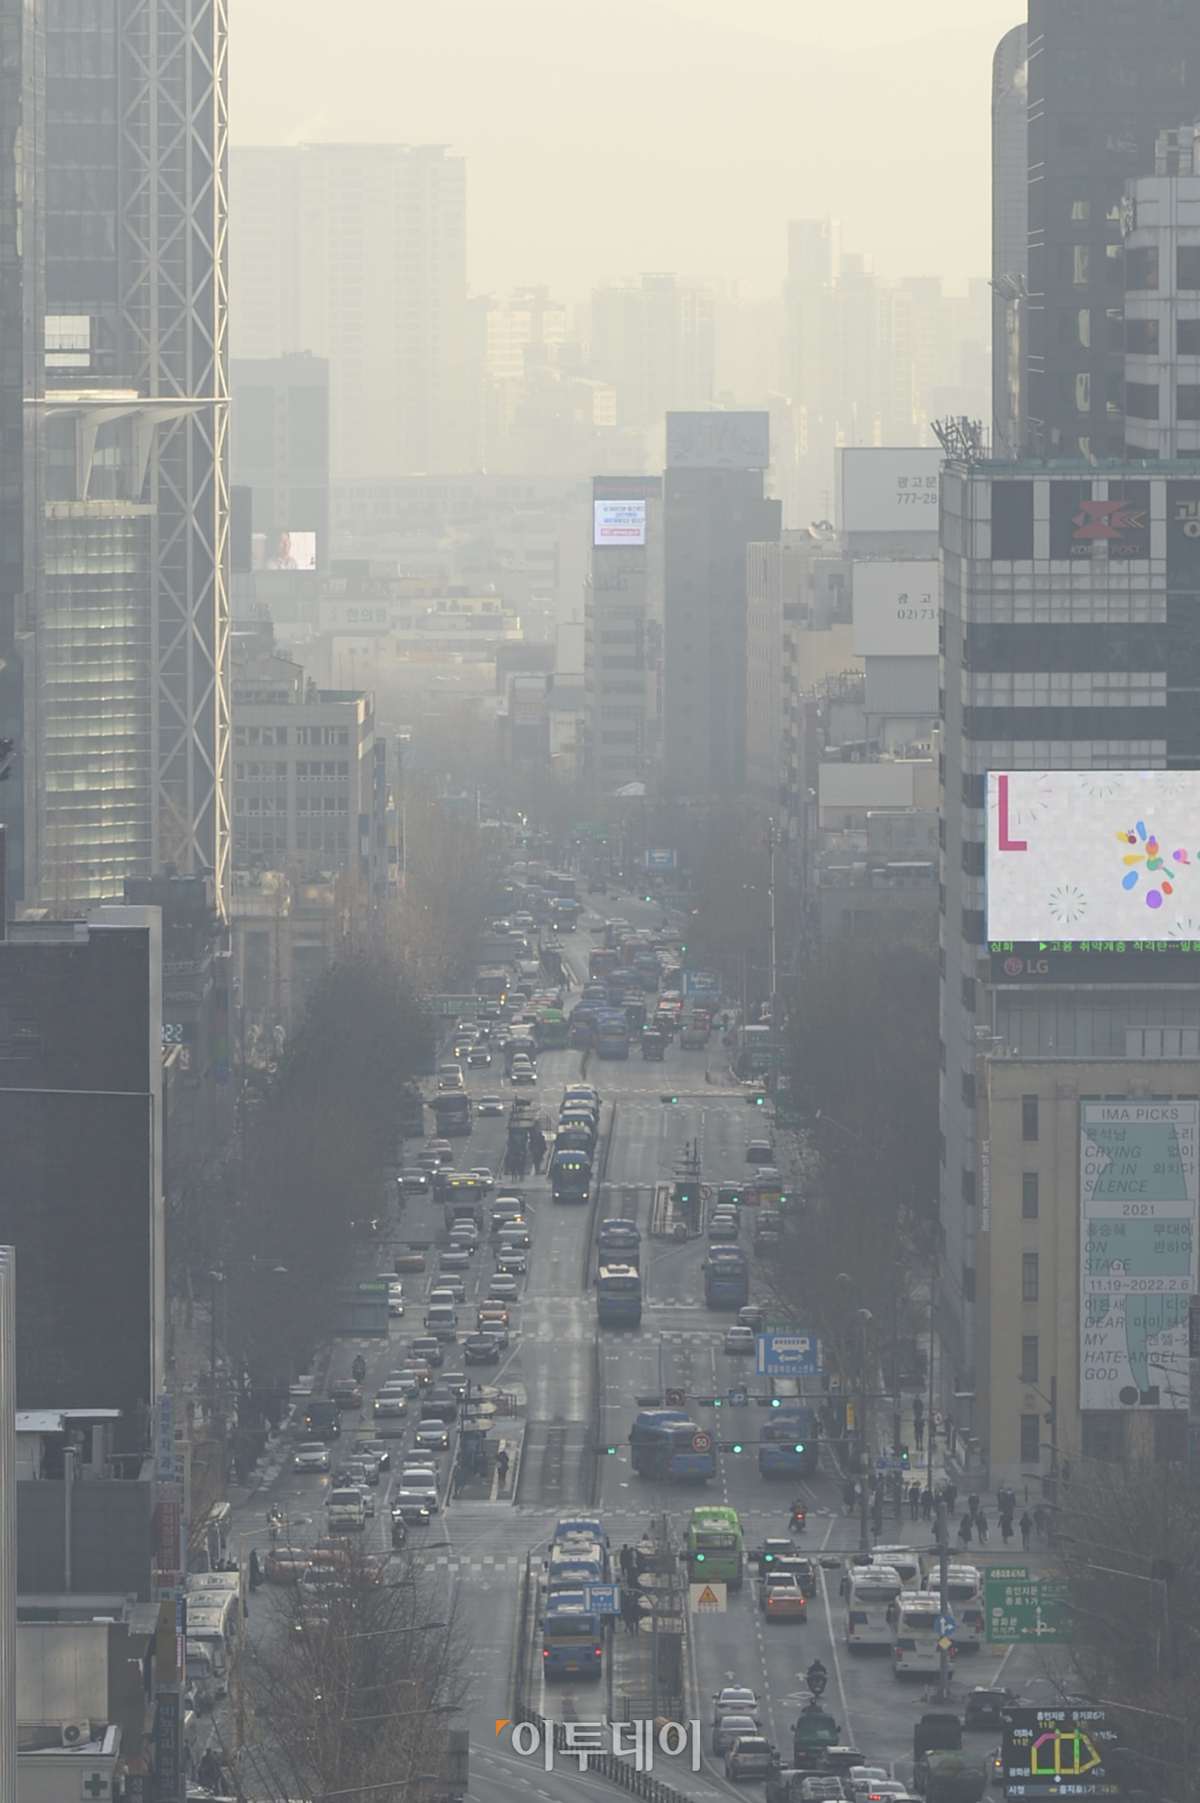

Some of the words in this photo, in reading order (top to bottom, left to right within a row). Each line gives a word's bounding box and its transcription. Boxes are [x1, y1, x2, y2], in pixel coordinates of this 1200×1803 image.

[896, 493, 937, 504] 777-28
[1111, 544, 1141, 556] POST
[346, 606, 387, 623] 한의원
[897, 608, 938, 620] 02)73
[1026, 959, 1049, 974] LG
[1101, 1109, 1130, 1120] IMA
[1136, 1109, 1179, 1120] PICKS
[1167, 1128, 1193, 1140] 소리
[1085, 1146, 1142, 1158] CRYING
[1167, 1146, 1193, 1158] 없이
[1085, 1163, 1116, 1175] OUT
[1121, 1163, 1137, 1175] IN
[1153, 1163, 1194, 1175] 외치다
[1084, 1180, 1148, 1193] SILENCE
[1122, 1205, 1155, 1216] 2021
[1153, 1224, 1193, 1236] 무대에
[1084, 1241, 1107, 1253] ON
[1153, 1241, 1193, 1254] 관하여
[1084, 1258, 1131, 1271] STAGE
[1090, 1280, 1189, 1291] 11.19~2022.2.6
[1084, 1317, 1124, 1329] DEAR
[1134, 1316, 1160, 1329] 마이
[1084, 1334, 1108, 1346] MY
[1084, 1351, 1178, 1363] HATE-ANGEL
[1084, 1368, 1119, 1380] GOD
[696, 1438, 707, 1448] 50
[160, 1705, 175, 1750] 비뇨기과
[161, 1756, 174, 1789] 피부과
